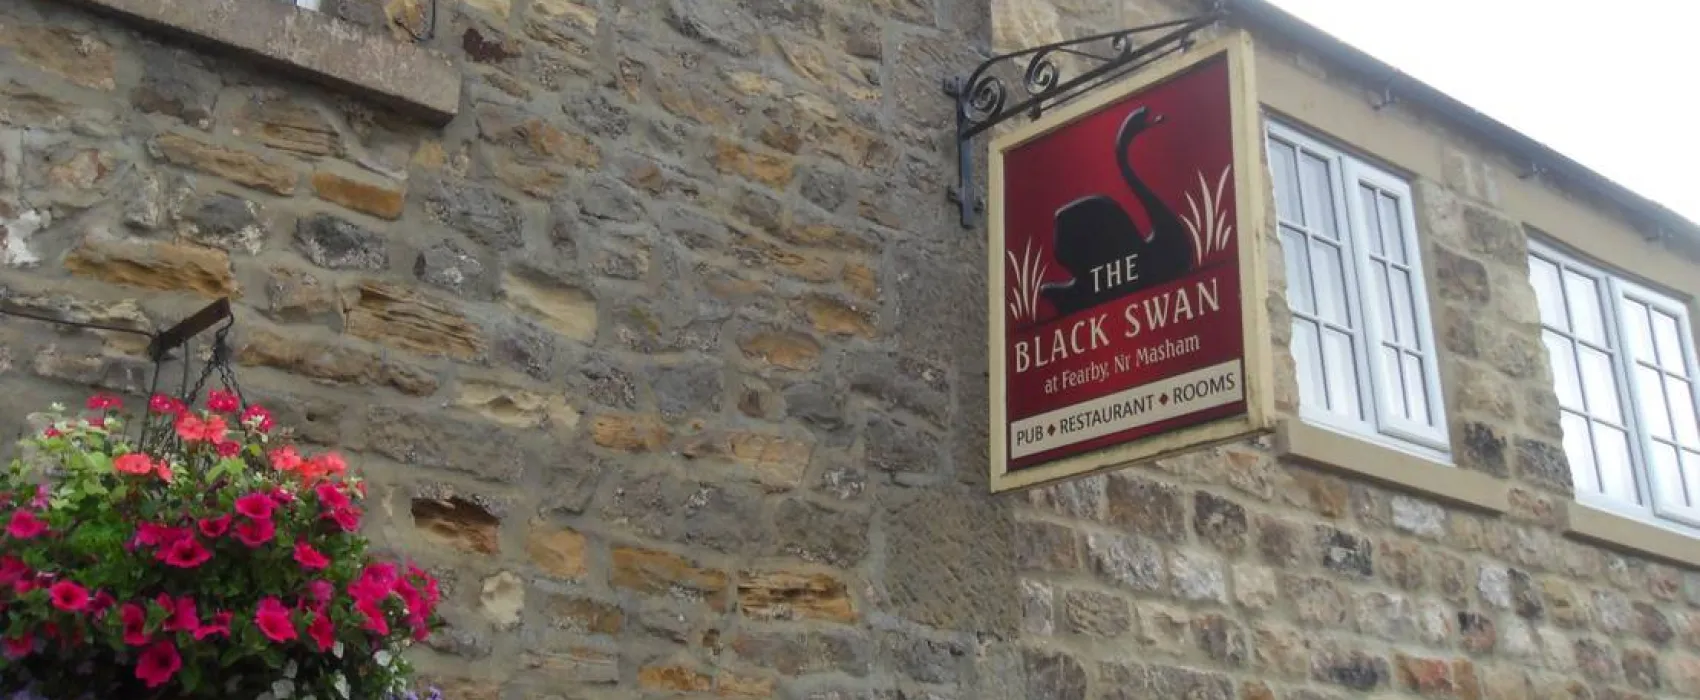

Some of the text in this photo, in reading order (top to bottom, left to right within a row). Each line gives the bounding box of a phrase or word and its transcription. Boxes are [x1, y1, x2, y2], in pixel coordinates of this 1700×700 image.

[1090, 254, 1139, 293] THE
[1014, 277, 1220, 373] BLACK SWAN
[1044, 334, 1200, 394] at Fearby, Nr Masham
[1016, 372, 1235, 446] PUB RESTAURANT ROOMS
